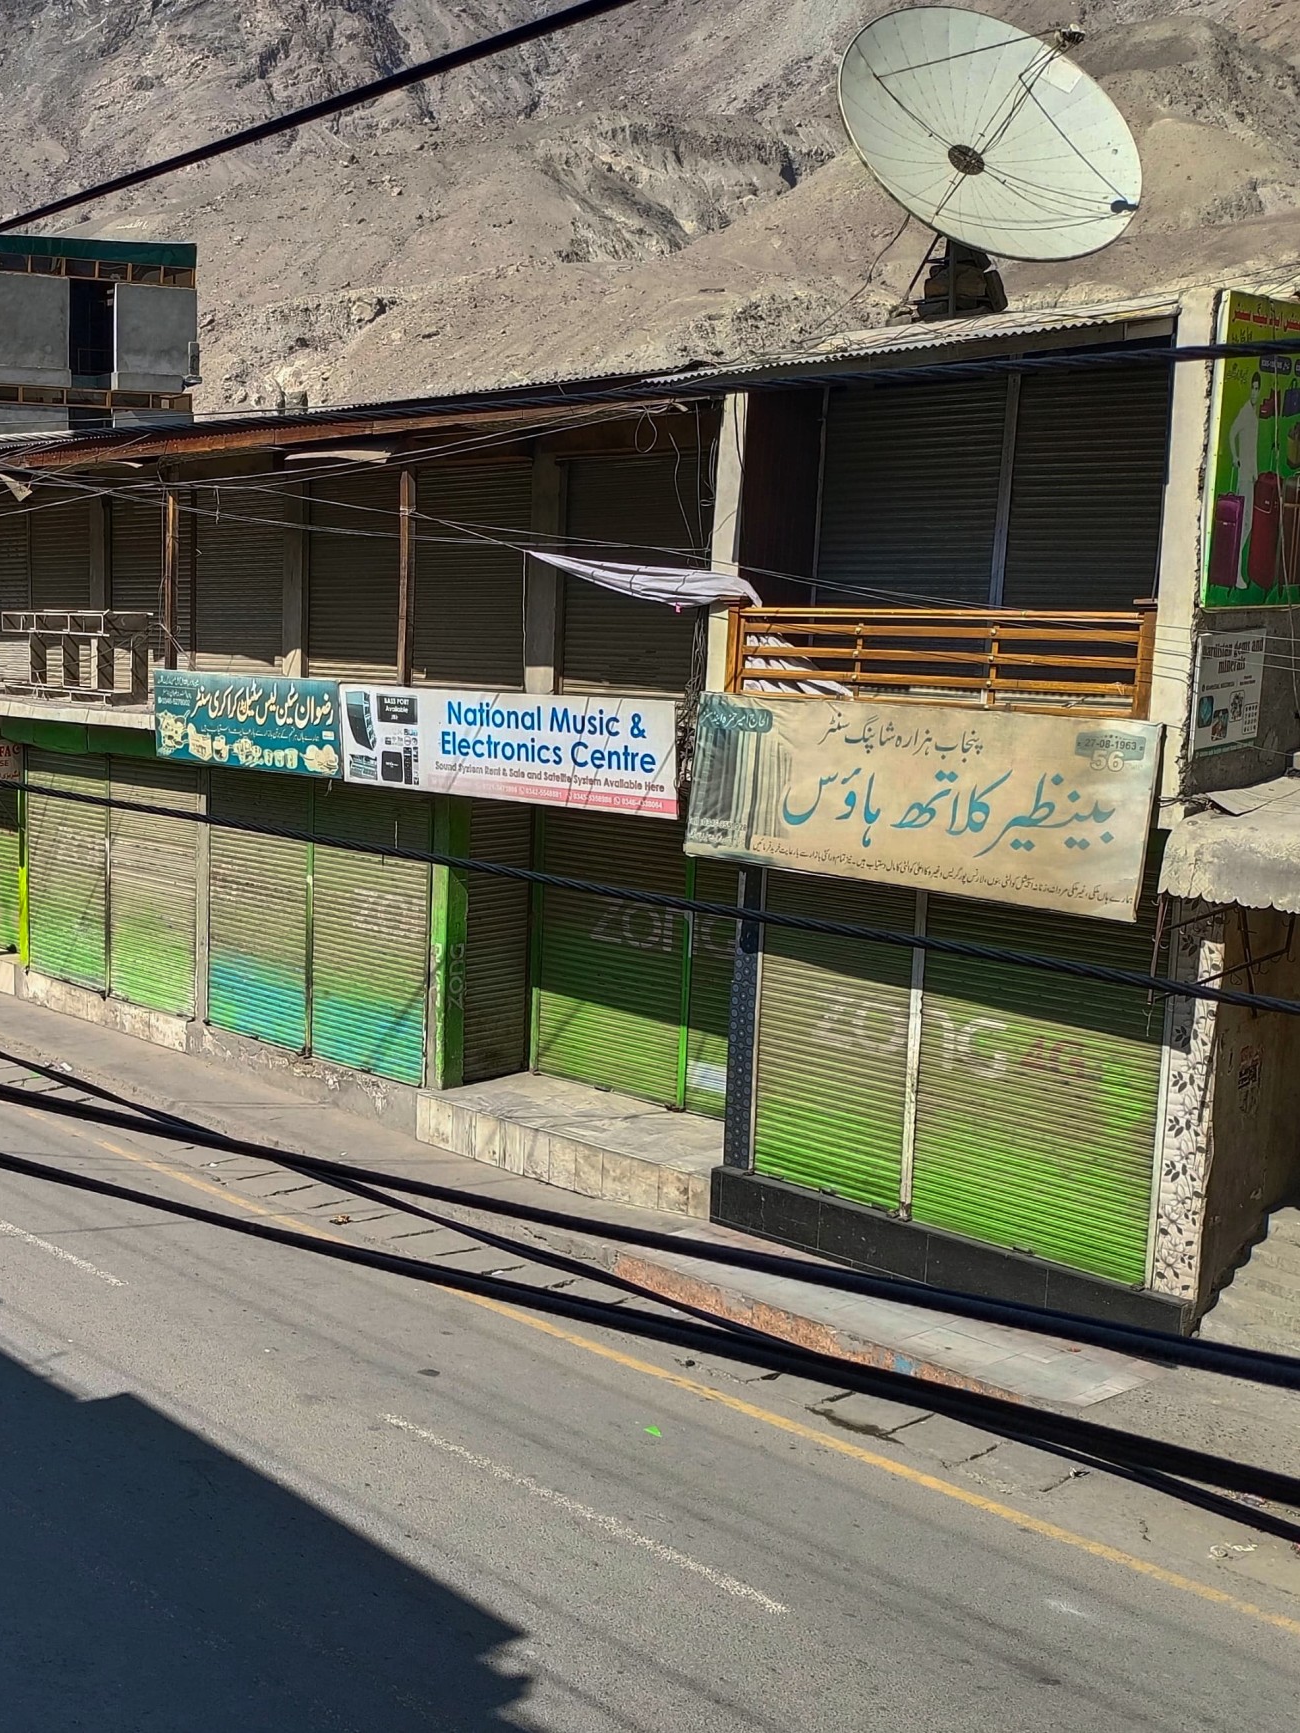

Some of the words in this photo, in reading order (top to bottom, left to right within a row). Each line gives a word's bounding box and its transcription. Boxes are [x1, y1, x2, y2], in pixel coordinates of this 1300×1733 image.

[294, 692, 334, 728] رضوان
[447, 700, 542, 732] National
[550, 706, 620, 736] Music
[630, 713, 646, 738] &
[441, 731, 563, 766] Electronics
[570, 742, 656, 774] Centre
[933, 733, 984, 762] پنجاب
[1084, 738, 1137, 750] 27-08-1963
[1090, 749, 1124, 772] 56
[435, 761, 457, 772] Sound
[484, 766, 501, 776] Rent
[502, 768, 508, 776] &
[509, 768, 525, 778] Sale
[526, 771, 542, 780] and
[604, 777, 642, 790] Available
[644, 781, 665, 792] Here
[782, 767, 882, 848] ہاؤس
[890, 768, 1013, 836] کلاتھ
[973, 768, 1116, 858] بینظیر
